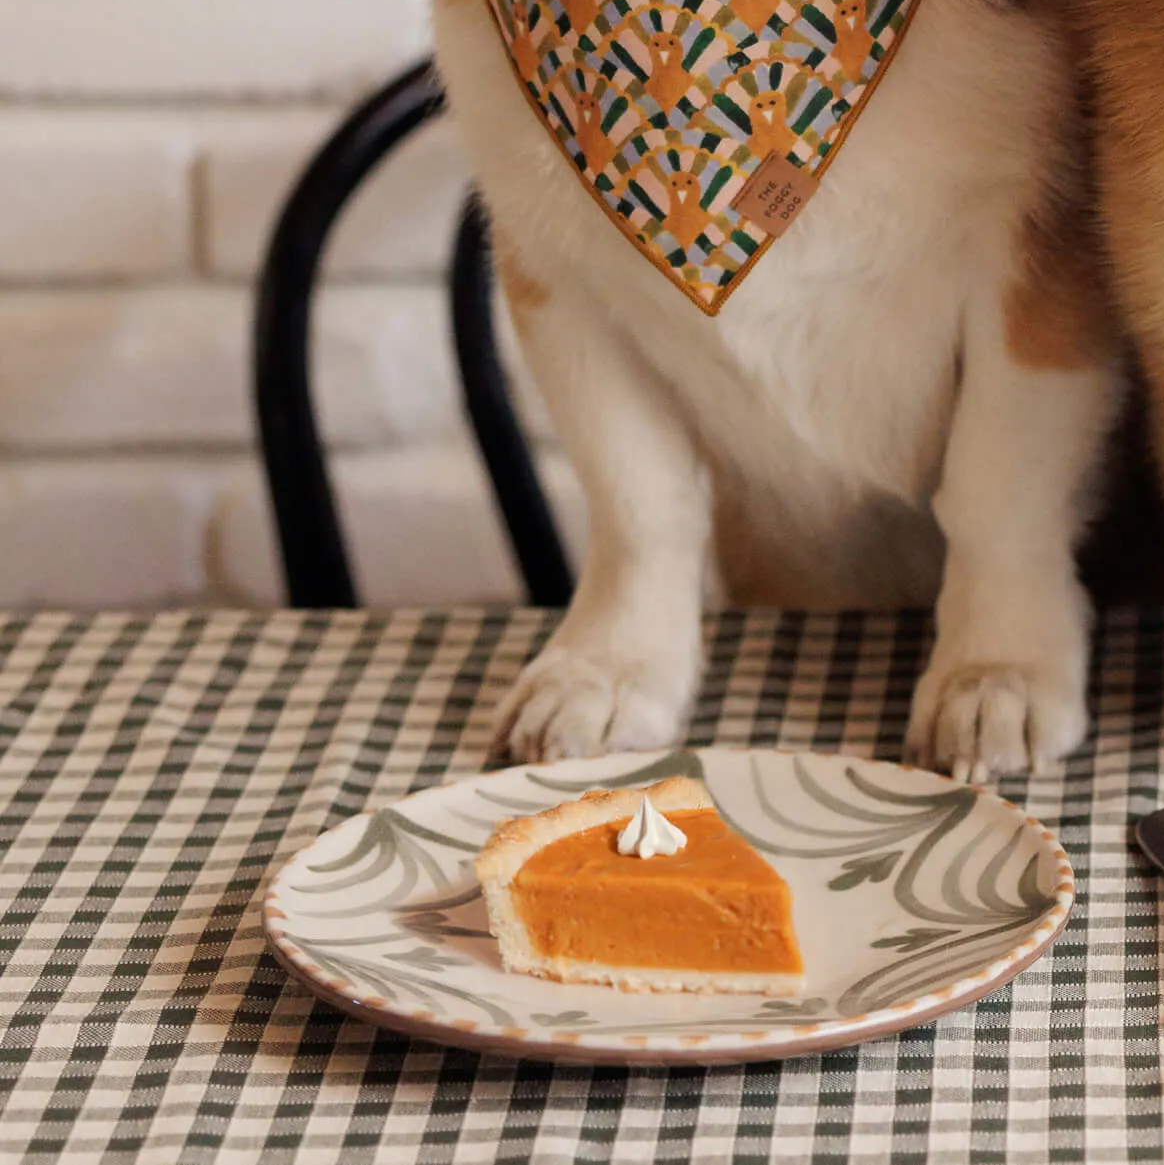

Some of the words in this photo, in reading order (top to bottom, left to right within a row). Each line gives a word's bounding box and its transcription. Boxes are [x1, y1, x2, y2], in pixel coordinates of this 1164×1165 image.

[758, 180, 777, 201] THE
[764, 181, 792, 218] FOGGY
[781, 196, 801, 220] DOG
